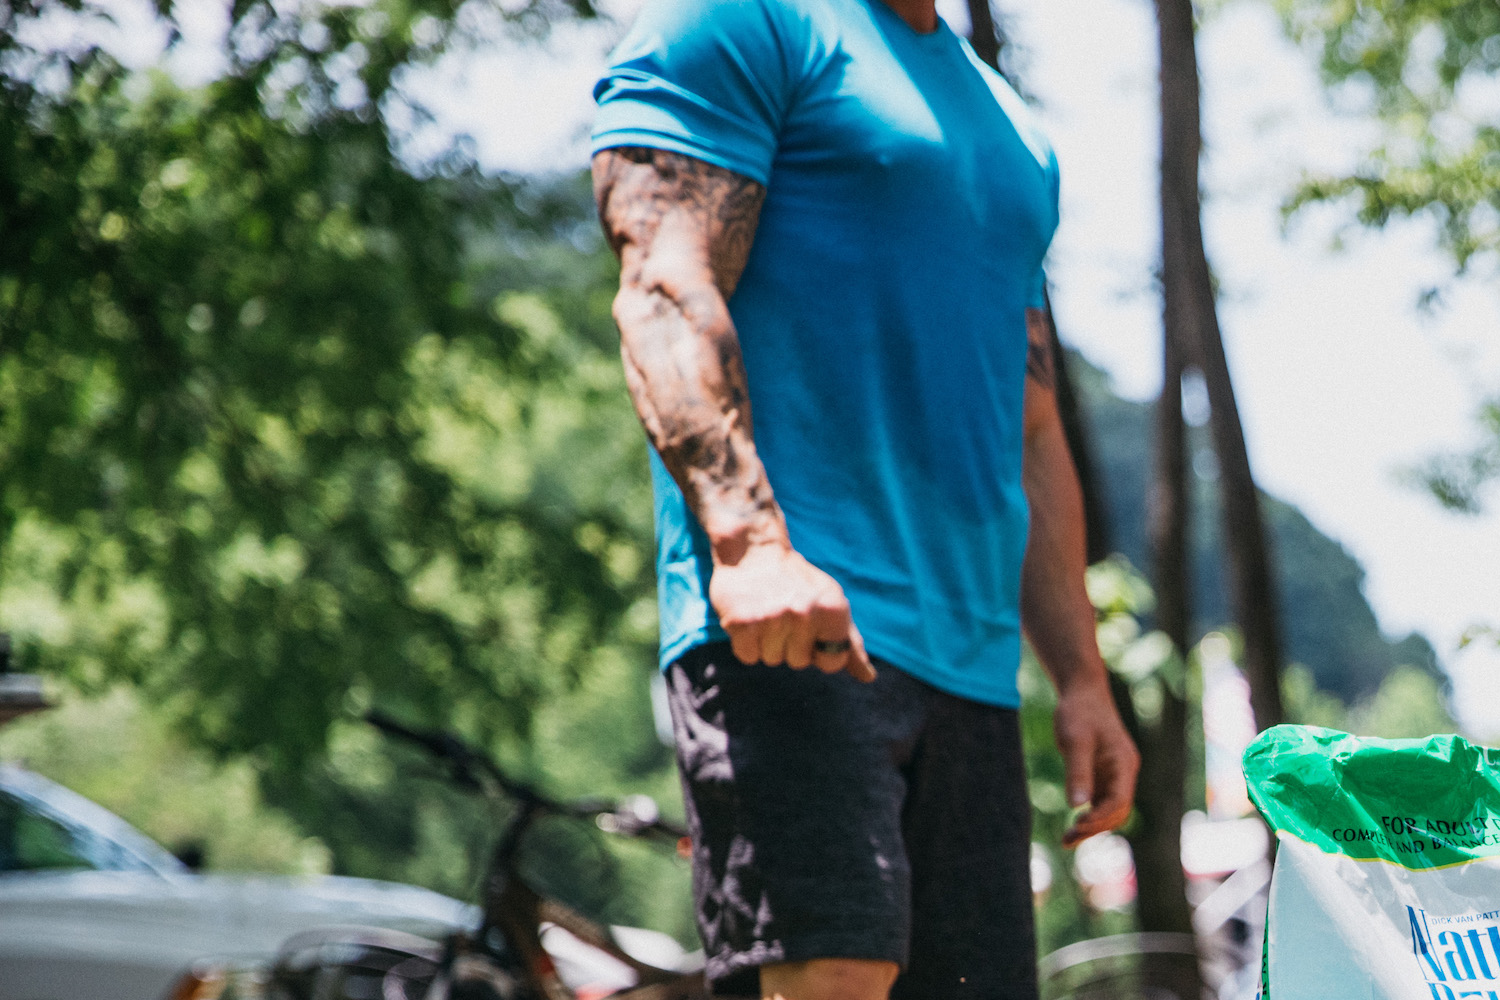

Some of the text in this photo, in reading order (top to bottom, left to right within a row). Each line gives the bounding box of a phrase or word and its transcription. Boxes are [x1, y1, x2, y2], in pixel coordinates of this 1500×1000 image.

[1382, 816, 1416, 836] FOR
[1426, 816, 1487, 838] ADULT
[1392, 839, 1425, 855] AND
[1431, 914, 1455, 926] DICK
[1455, 911, 1474, 923] VAN
